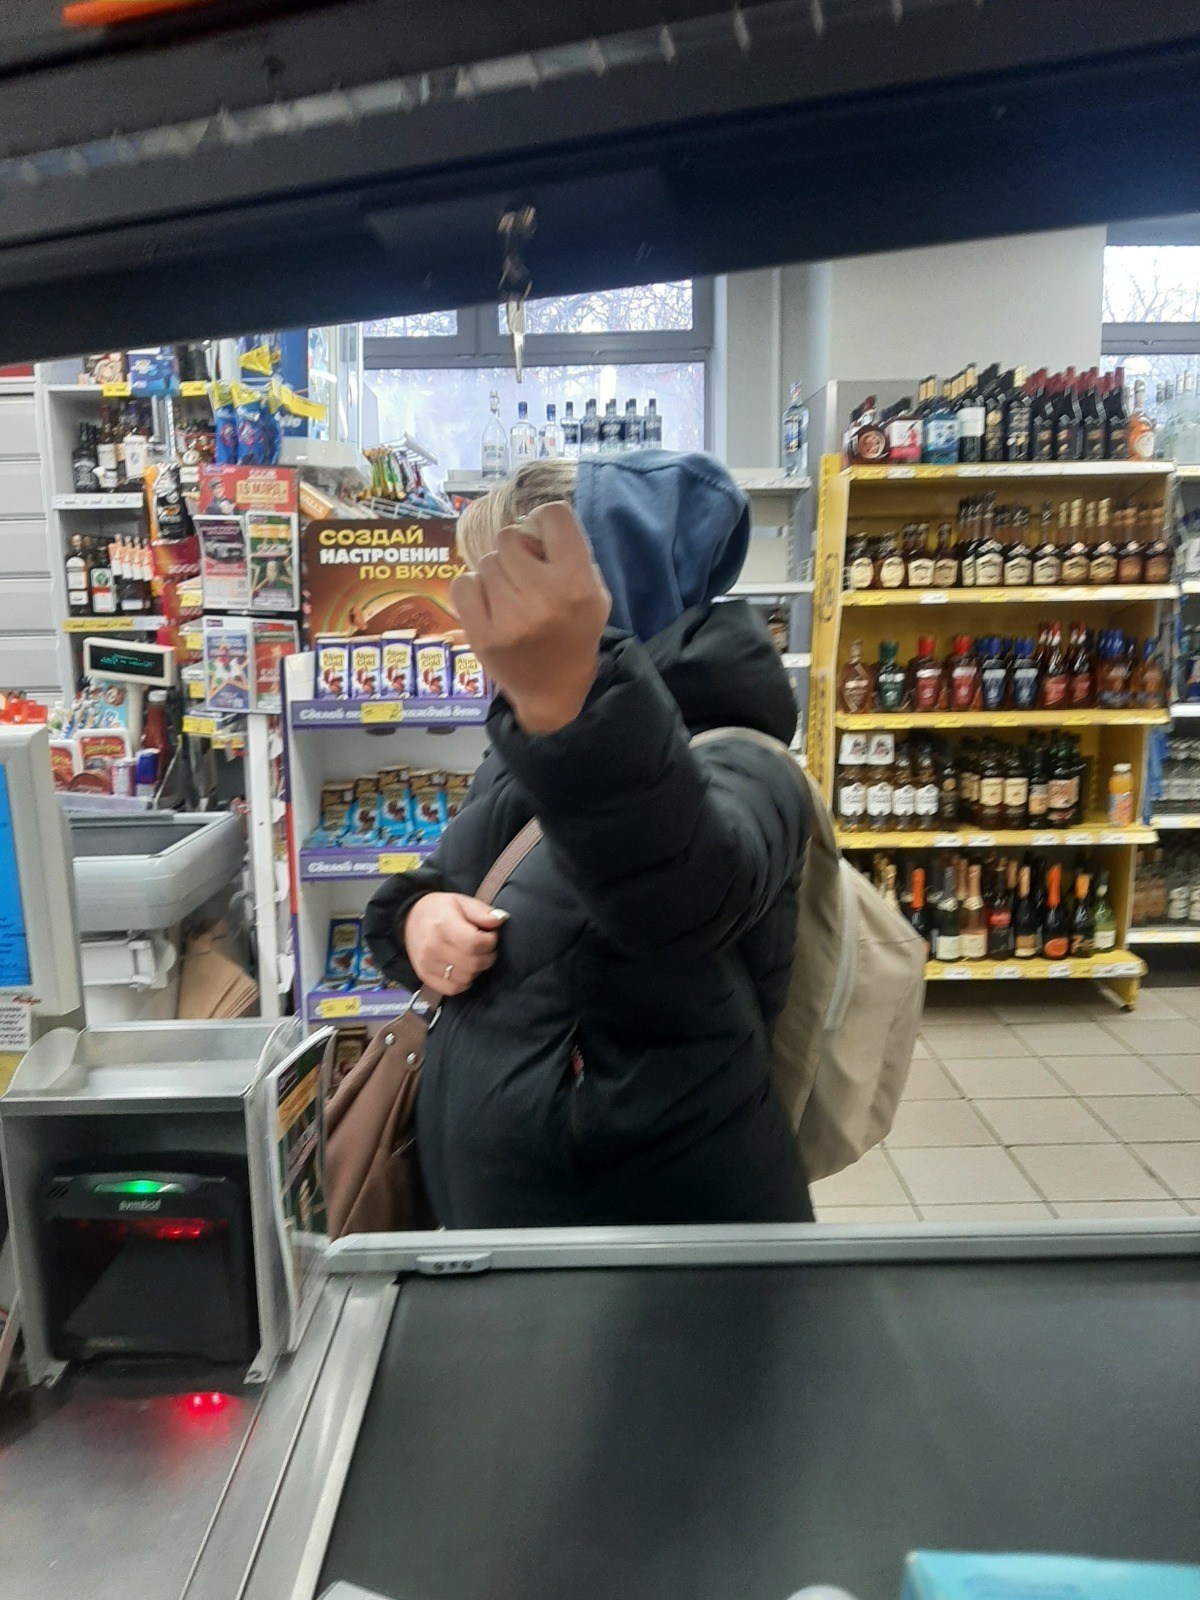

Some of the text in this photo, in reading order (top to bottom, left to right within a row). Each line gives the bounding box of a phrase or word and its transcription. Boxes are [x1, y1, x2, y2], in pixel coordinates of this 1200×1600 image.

[318, 525, 424, 546] СОЗДАЙ
[320, 547, 449, 564] НАСТРОЕНИЕ
[359, 564, 467, 580] ПО ВКУСУ
